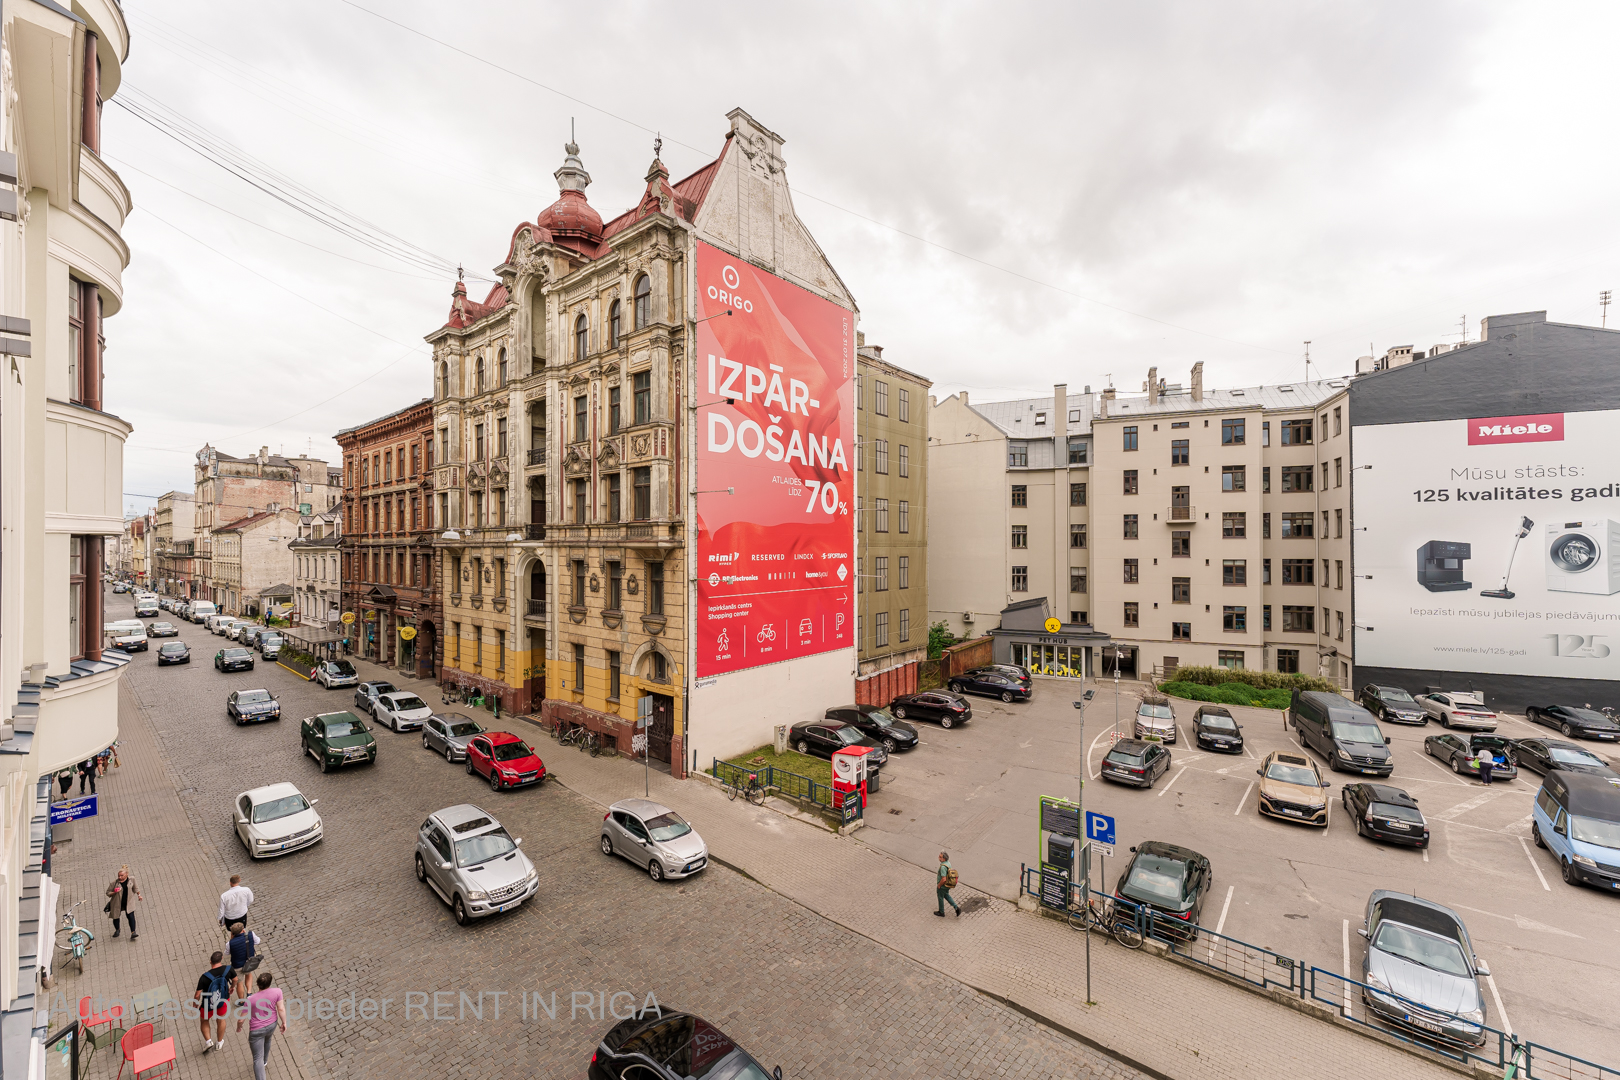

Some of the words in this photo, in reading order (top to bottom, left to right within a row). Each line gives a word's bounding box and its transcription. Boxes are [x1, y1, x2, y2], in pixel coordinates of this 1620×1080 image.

[707, 285, 753, 313] ORIGO
[708, 354, 820, 417] IZPĀR-
[1478, 423, 1553, 437] Miele
[708, 412, 848, 472] DOŠANA
[1450, 467, 1506, 481] Mūsu
[1514, 464, 1585, 479] stāsts:
[772, 476, 801, 486] ATLAIDES
[788, 487, 802, 496] LĪDZ
[805, 480, 848, 515] 70%
[1413, 489, 1450, 502] 125
[1457, 486, 1563, 501] kvalitātes
[708, 553, 733, 562] Rimi
[708, 612, 733, 620] Shopping
[1410, 607, 1455, 617] Iepazīsti
[1458, 608, 1490, 617] mūsu
[1492, 608, 1542, 621] jubilejas
[1433, 646, 1527, 656] www.miele.lv/125-gadi
[1544, 633, 1611, 659] 125
[51, 804, 92, 817] ERONAUTICA
[56, 811, 82, 819] MILITARE
[1092, 815, 1108, 837] P
